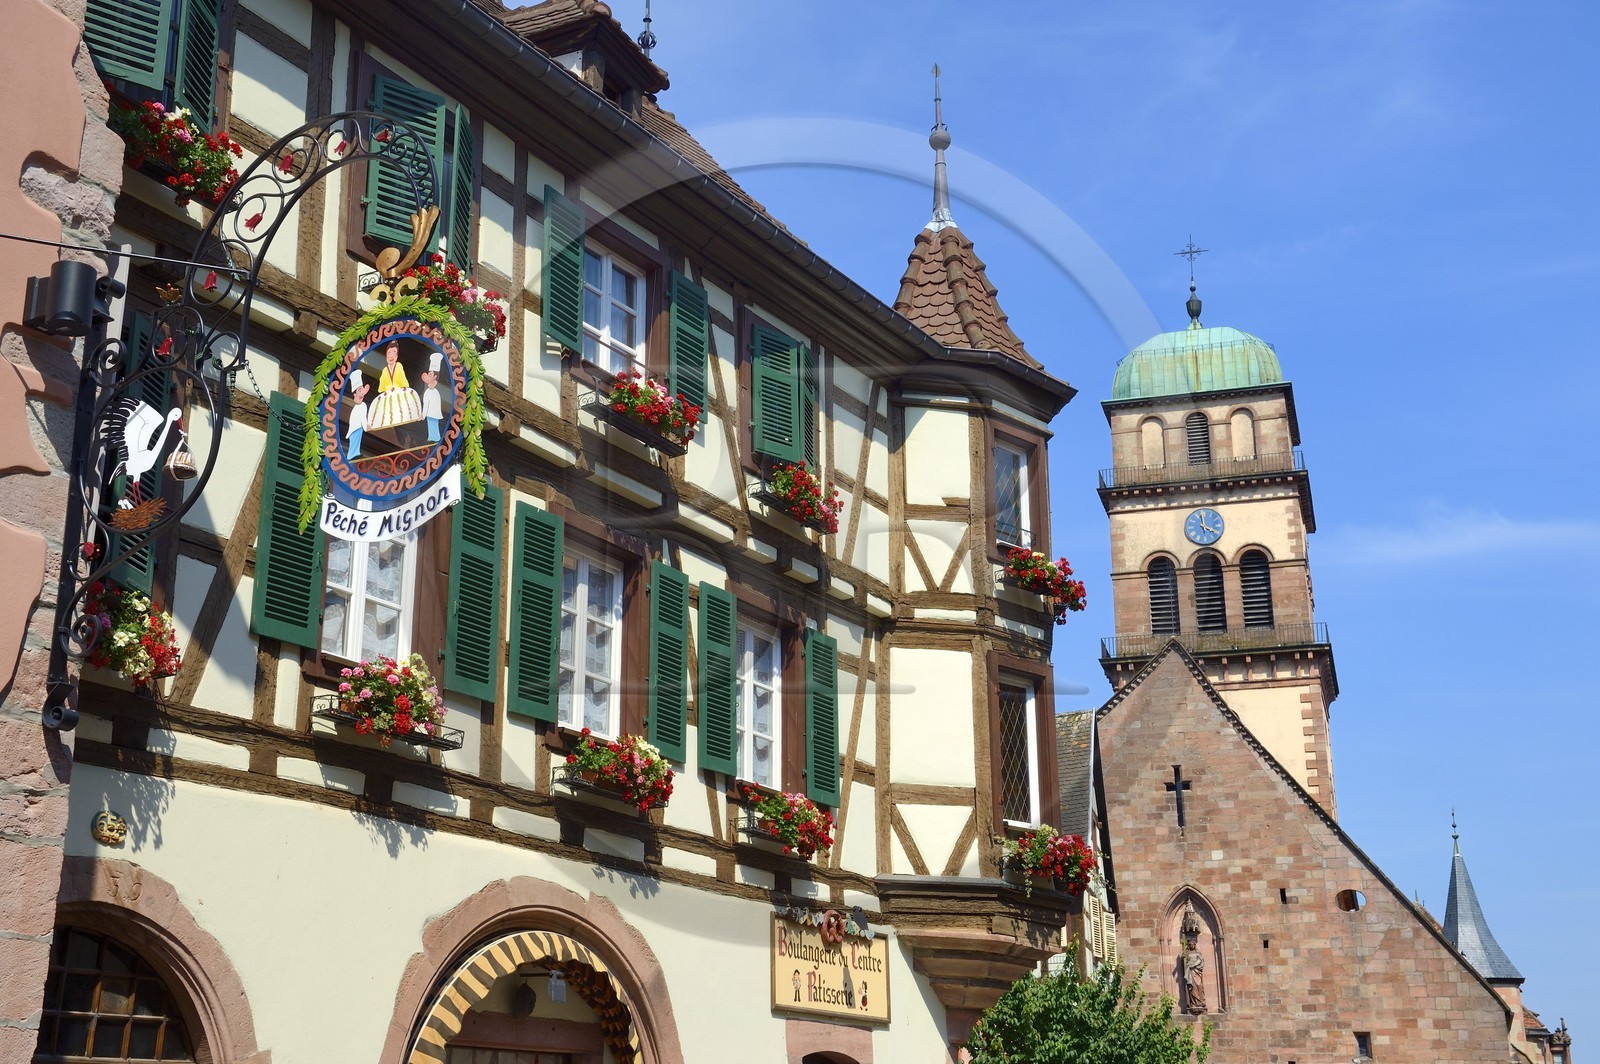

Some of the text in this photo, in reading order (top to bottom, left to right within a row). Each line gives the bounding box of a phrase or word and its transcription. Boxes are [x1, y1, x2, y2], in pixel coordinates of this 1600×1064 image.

[325, 486, 450, 538] Péché Mignon
[777, 925, 882, 973] Boulangerie du Centre
